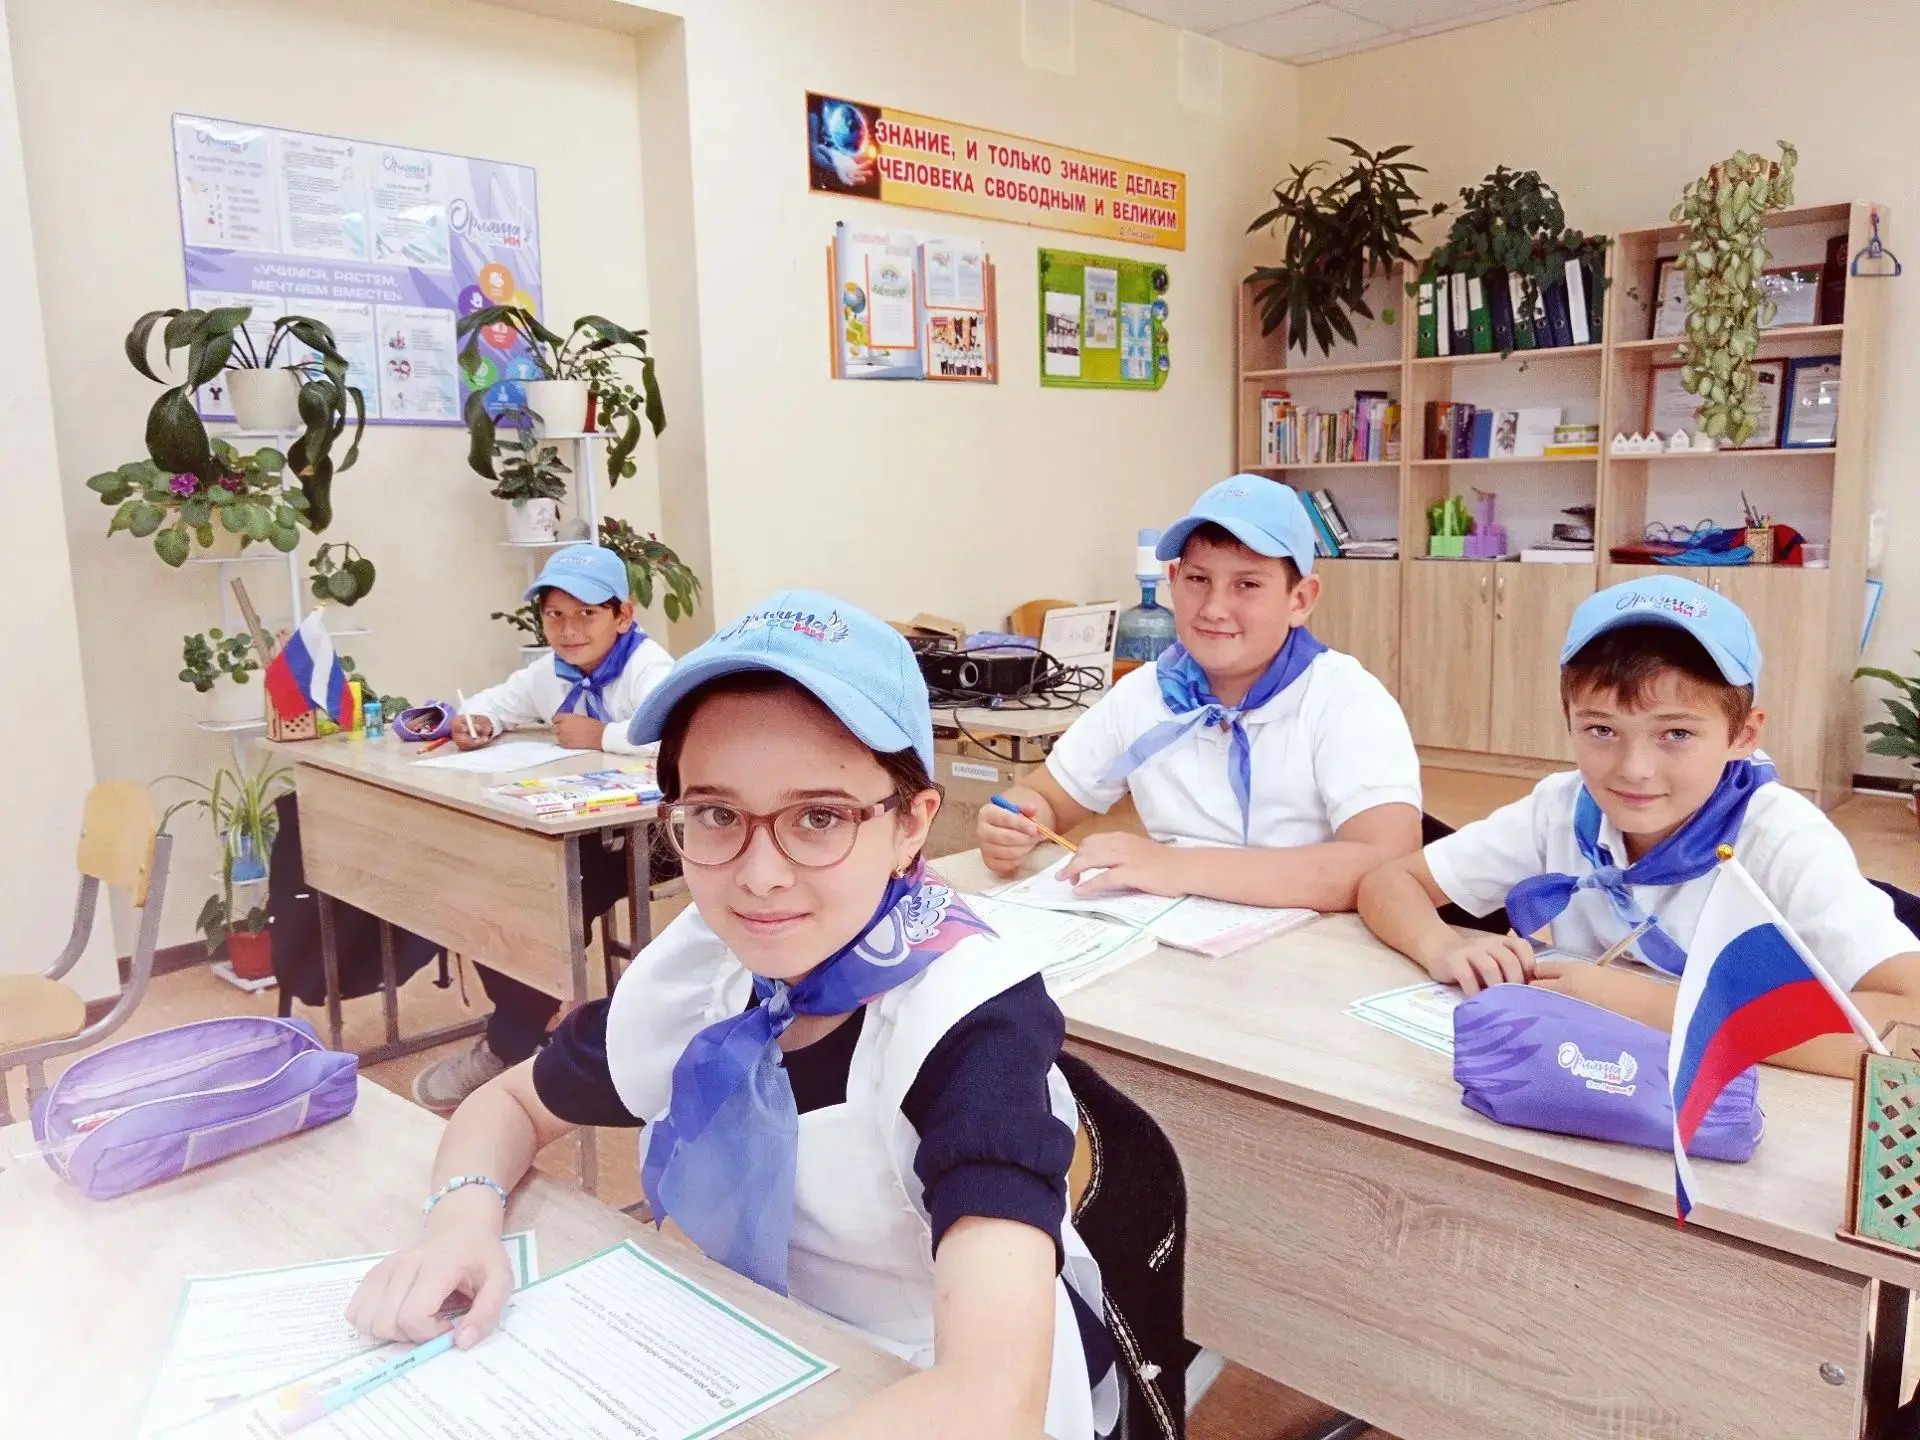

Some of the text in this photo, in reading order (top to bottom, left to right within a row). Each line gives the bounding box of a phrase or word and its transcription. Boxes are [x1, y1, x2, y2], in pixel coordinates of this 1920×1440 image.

[875, 121, 1178, 201] ЗНАНИЕ, И ТОЛЬКО ЗНАНИЕ ДЕЛАЕТ
[878, 157, 1177, 229] ЧЕЛОВЕКА СВОБОДНЫМ И ВЕЛИКИМ
